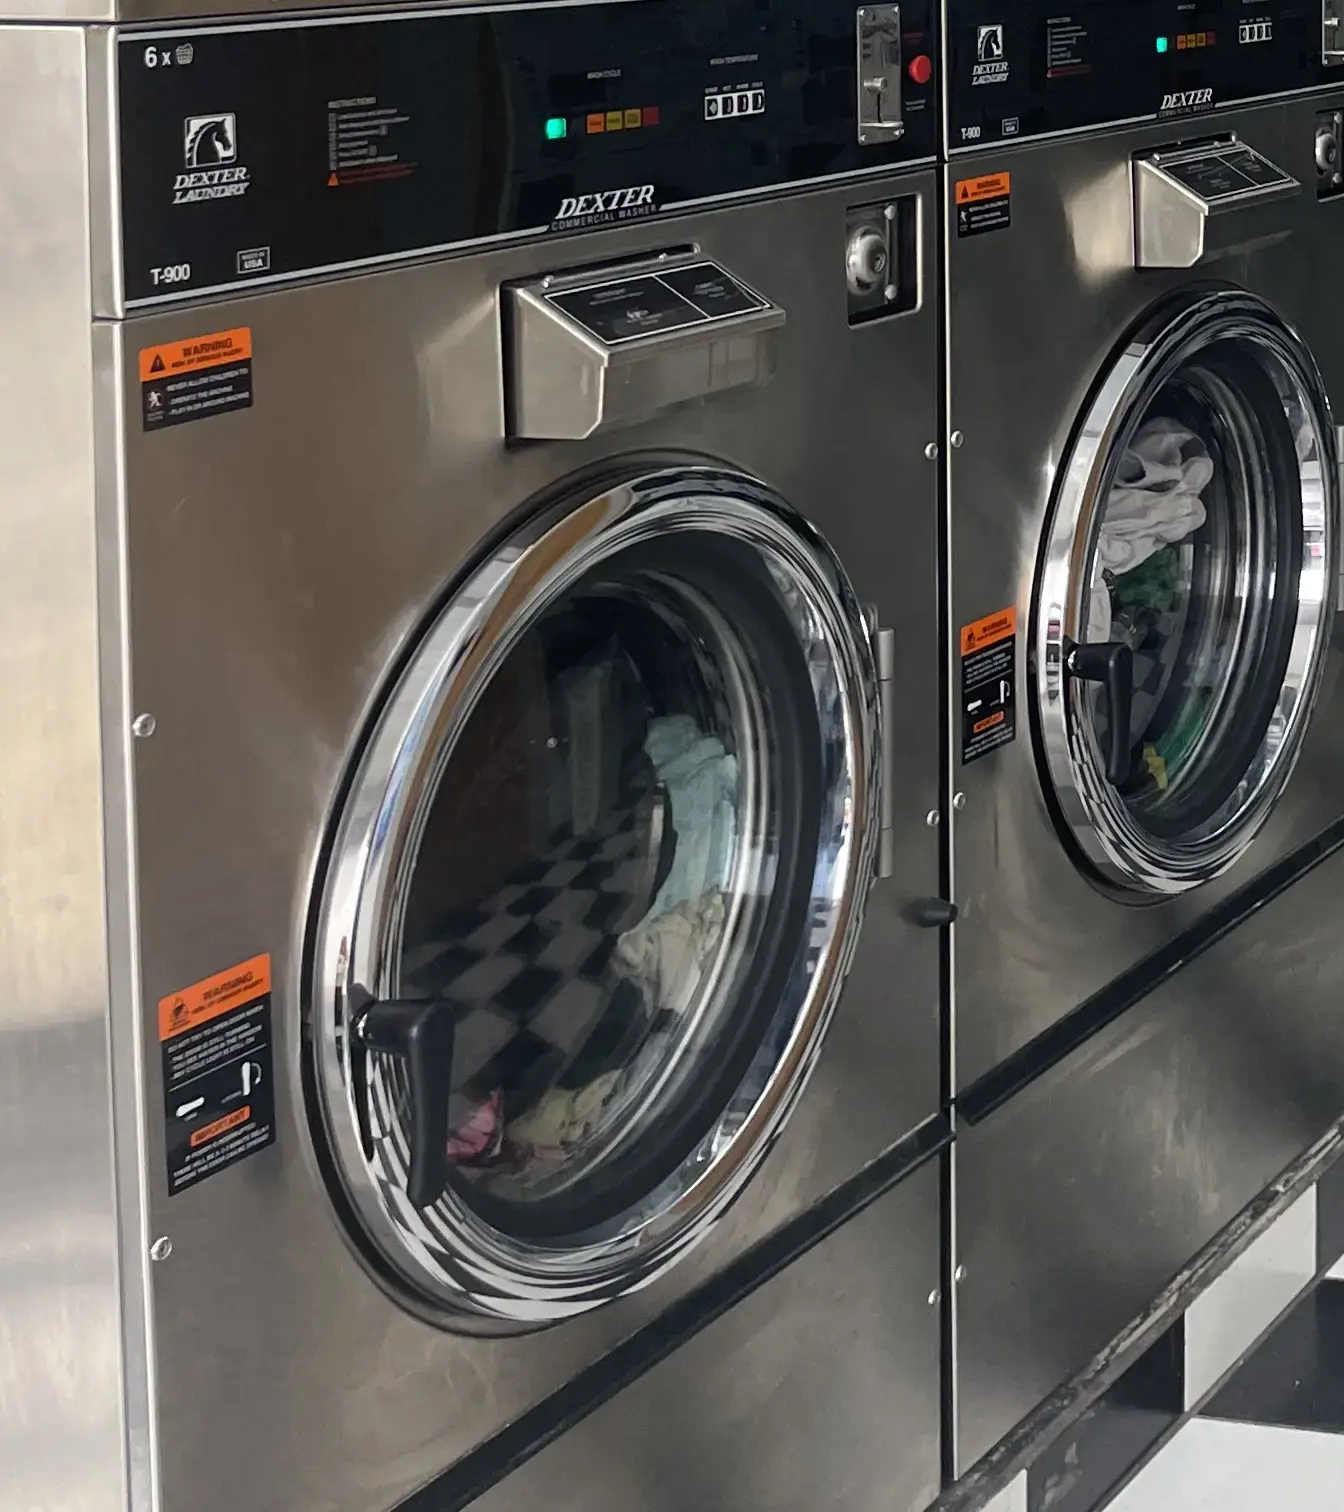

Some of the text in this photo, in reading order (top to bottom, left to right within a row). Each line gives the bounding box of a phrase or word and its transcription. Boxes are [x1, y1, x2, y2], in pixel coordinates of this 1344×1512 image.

[144, 46, 171, 68] 6 x
[972, 62, 1009, 75] DEXTER
[1160, 87, 1213, 110] DEXTER
[173, 167, 248, 189] DEXTER
[172, 182, 250, 204] LAUNDRY
[555, 184, 655, 220] DEXTER
[551, 203, 657, 231] COMMERCIAL WASHER
[150, 264, 190, 285] T-900
